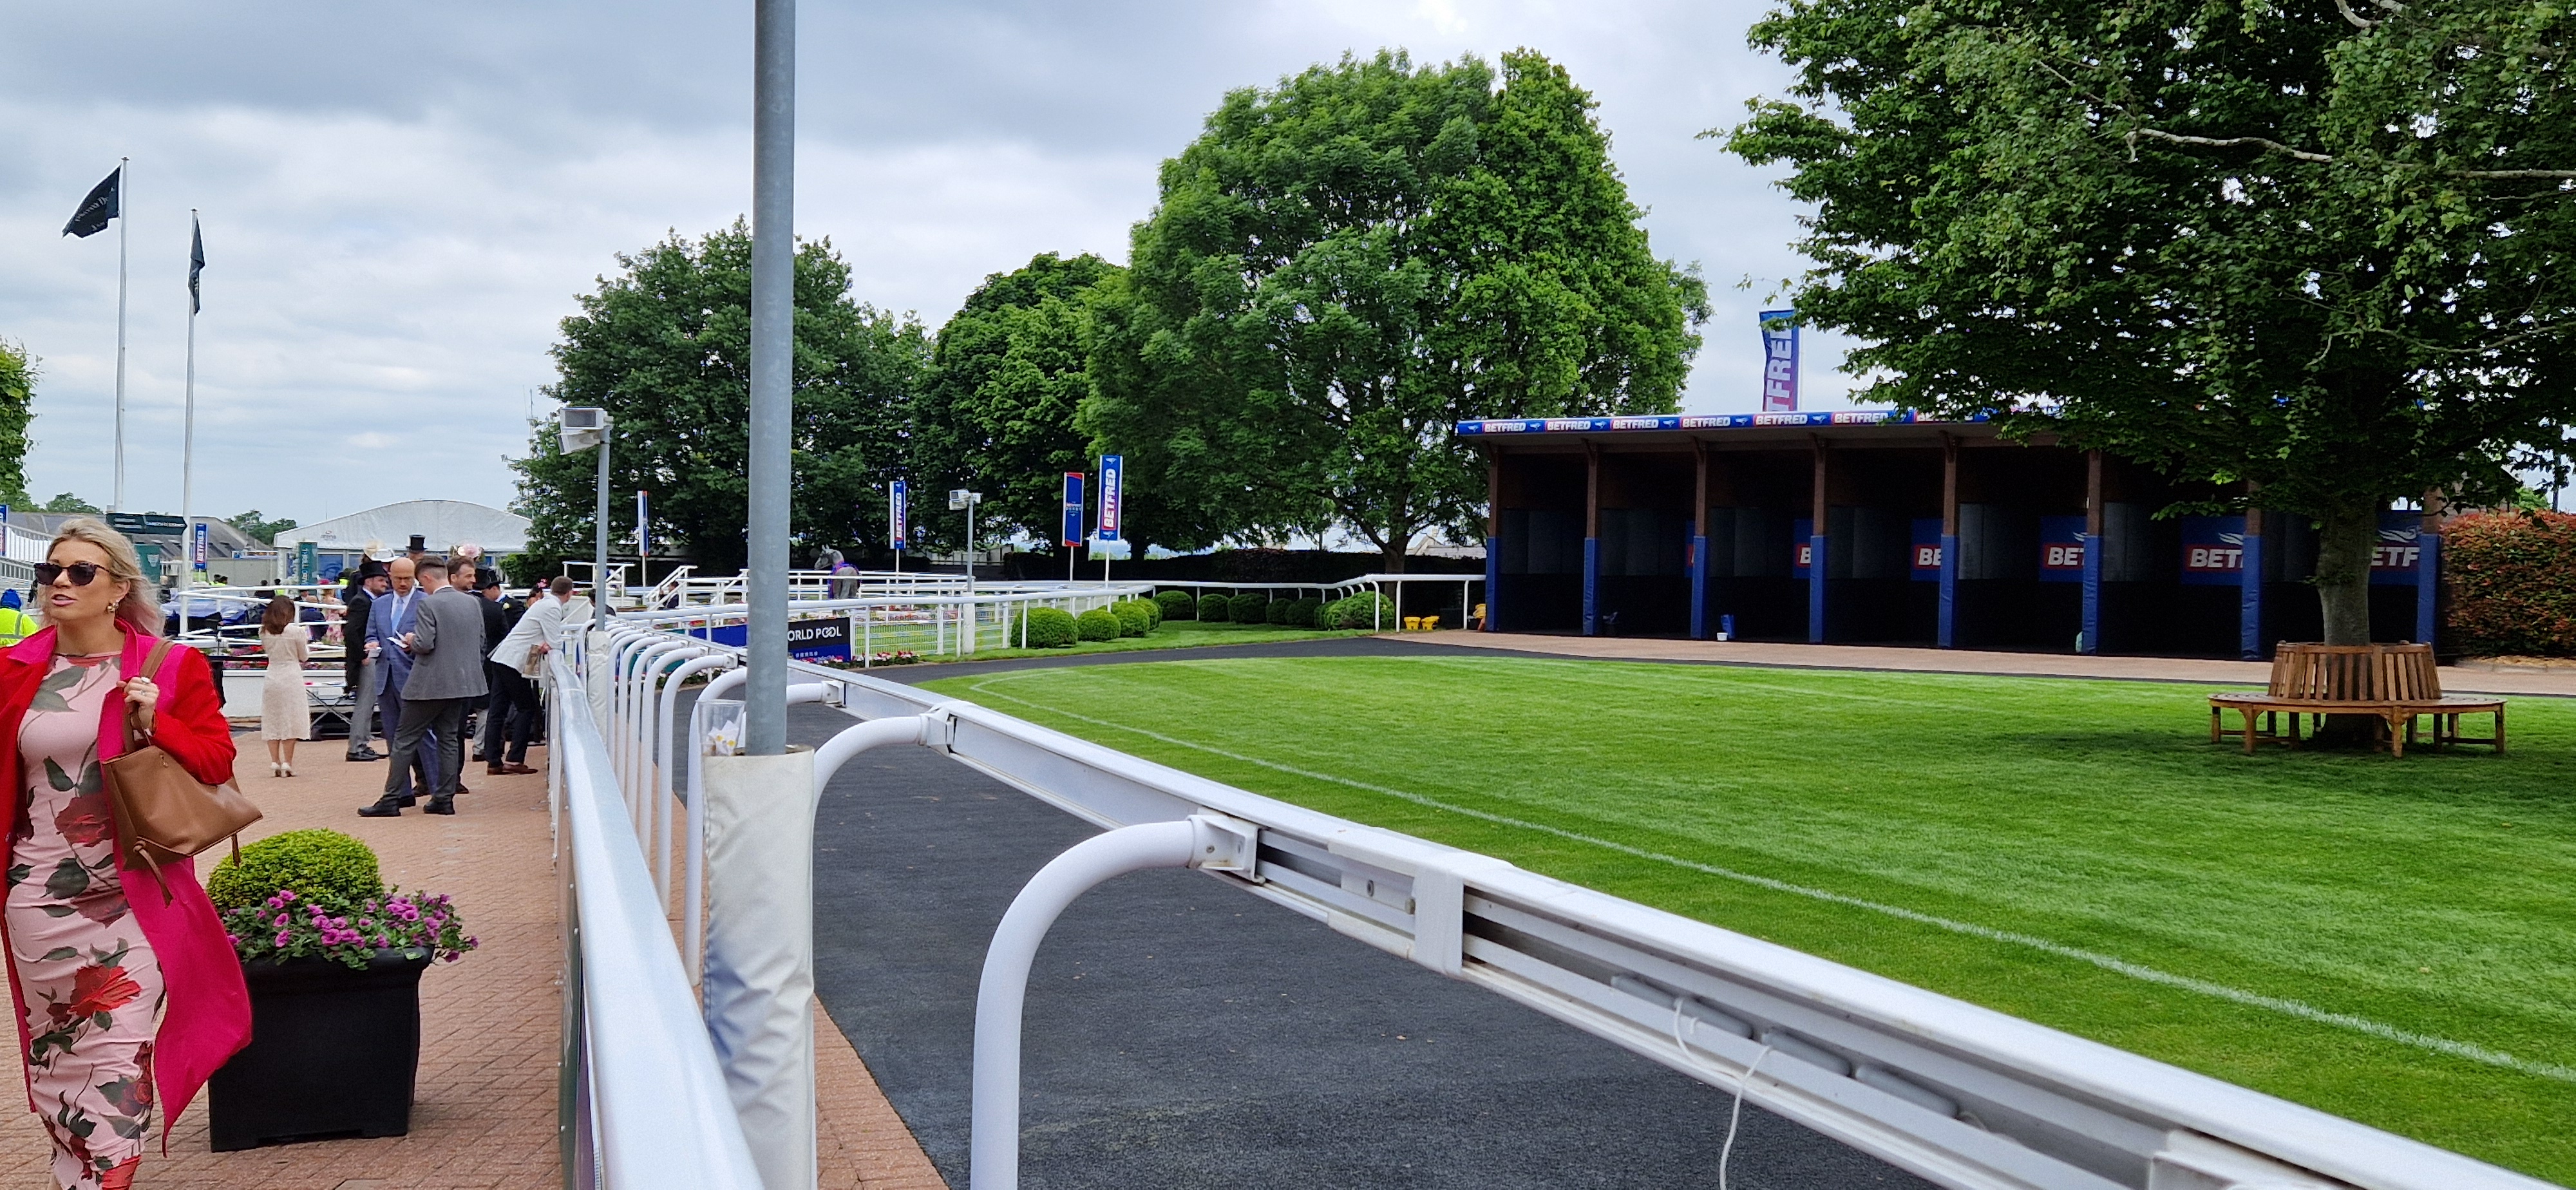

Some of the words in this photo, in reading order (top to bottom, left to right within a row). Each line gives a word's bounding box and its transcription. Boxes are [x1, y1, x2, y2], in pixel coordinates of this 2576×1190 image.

[1484, 422, 1526, 433] BETFRED
[1547, 421, 1591, 431] BETFRED
[1613, 419, 1659, 429] BETFRED
[1683, 417, 1730, 428] BETFRED
[1756, 414, 1808, 425] BETFRED
[1103, 468, 1115, 528] BETFRED
[2190, 549, 2243, 568] BET
[788, 628, 813, 641] ORLD
[815, 625, 842, 639] POOL
